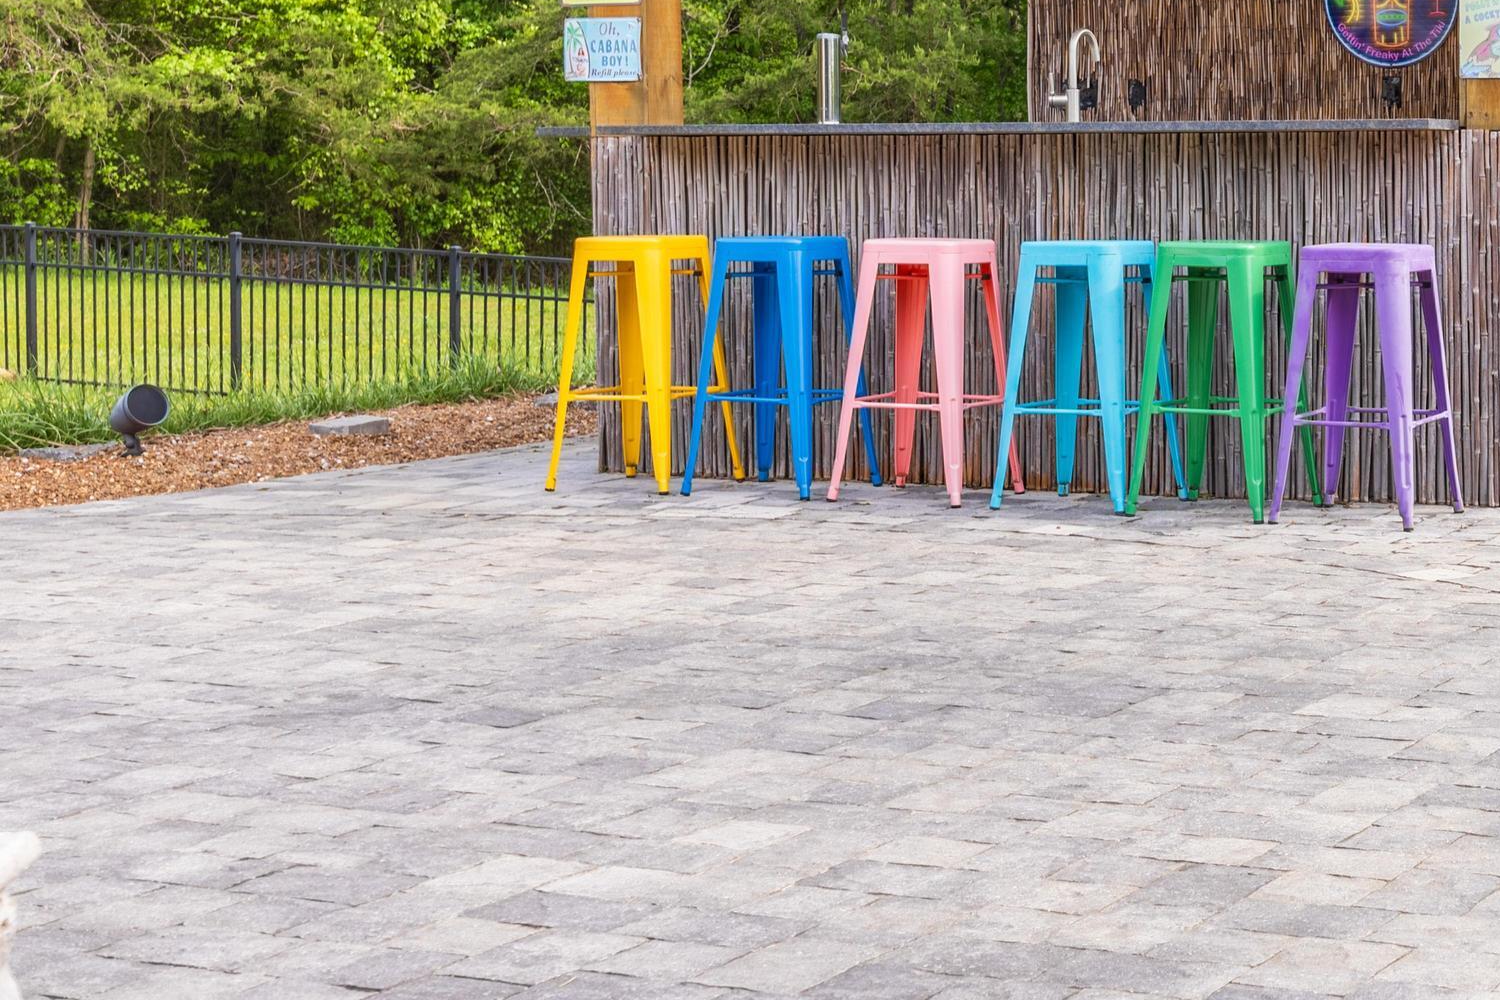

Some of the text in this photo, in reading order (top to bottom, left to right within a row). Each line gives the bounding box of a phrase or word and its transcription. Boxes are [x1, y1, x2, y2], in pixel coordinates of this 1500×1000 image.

[1465, 16, 1471, 25] A
[599, 21, 620, 36] Oh,
[590, 39, 637, 54] CABANA
[1337, 21, 1446, 60] Gettin' Freaky At The Tiki
[601, 55, 629, 67] BOY!
[591, 68, 612, 77] Refill
